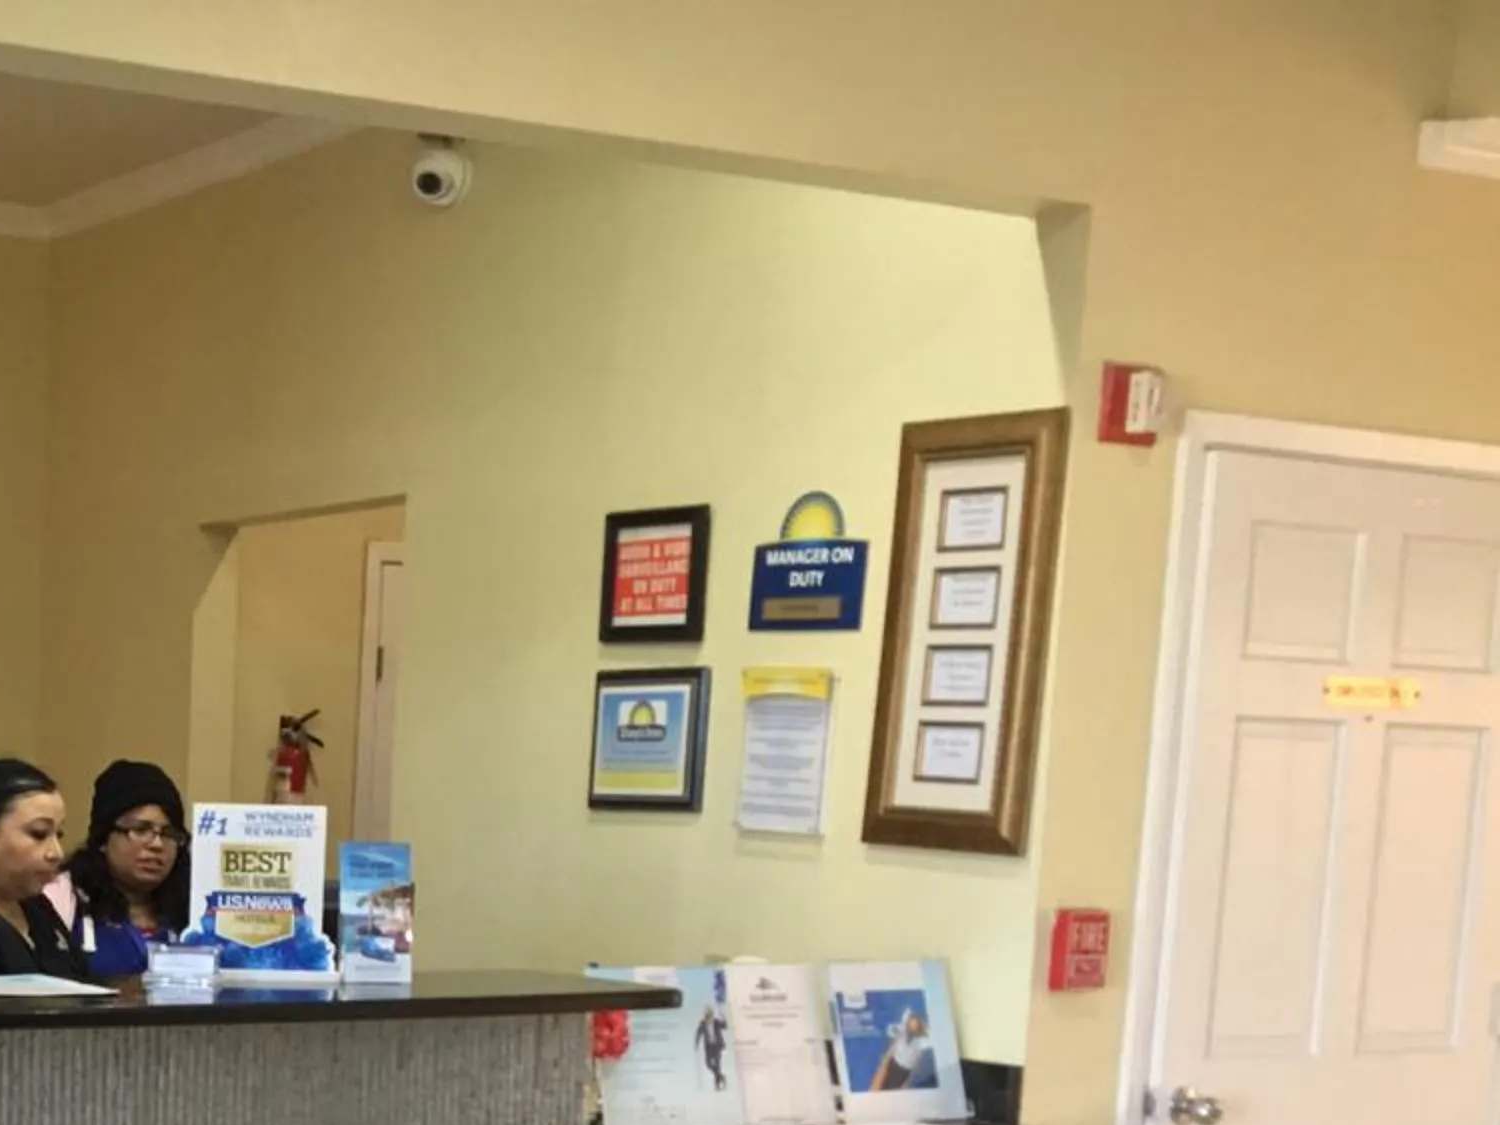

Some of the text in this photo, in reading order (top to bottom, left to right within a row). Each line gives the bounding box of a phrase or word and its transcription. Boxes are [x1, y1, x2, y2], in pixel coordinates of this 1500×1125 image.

[766, 546, 855, 566] MANAGER ON
[789, 569, 825, 588] DUTY
[198, 810, 228, 836] #1
[224, 849, 292, 873] BEST
